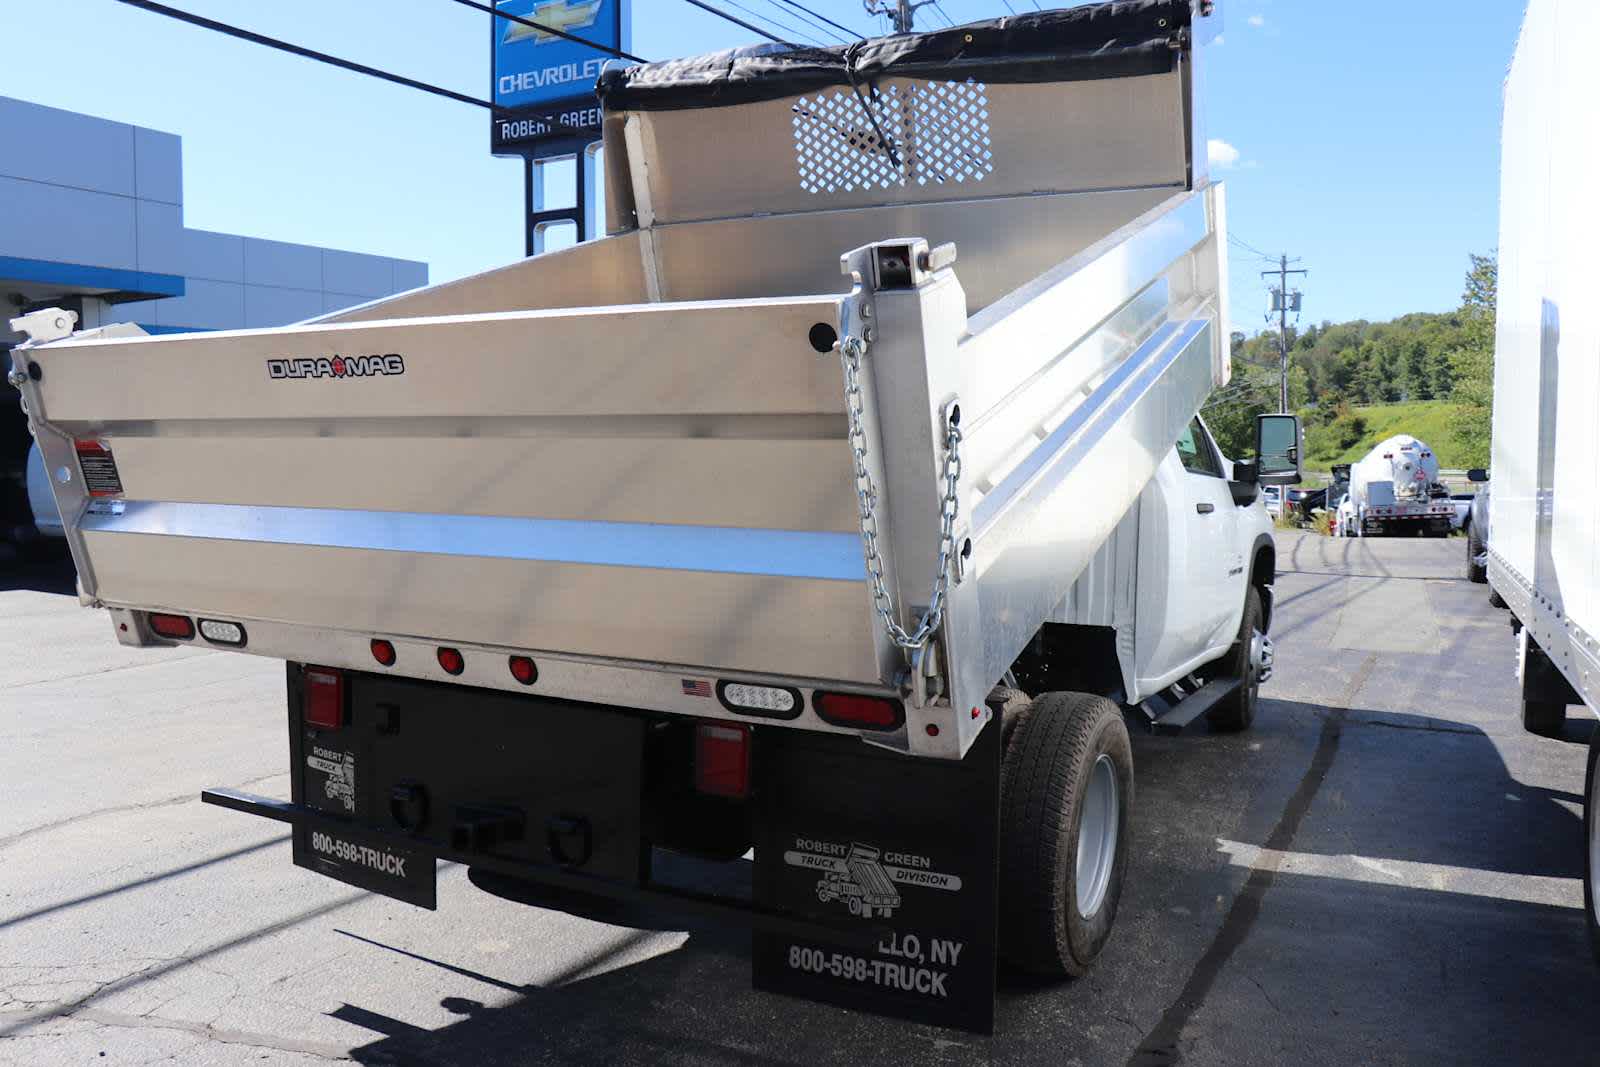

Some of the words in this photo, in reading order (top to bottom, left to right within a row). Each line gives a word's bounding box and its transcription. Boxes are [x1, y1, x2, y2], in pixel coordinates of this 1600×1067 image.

[500, 58, 607, 94] CHEVROLET
[313, 746, 342, 762] ROBERT
[316, 760, 337, 771] TRUCK
[312, 832, 406, 878] 800-598-TRUCK
[796, 838, 847, 855] ROBERT
[884, 852, 931, 868] GREEN
[800, 855, 836, 869] TRUCK
[896, 870, 949, 887] DIVISION
[930, 939, 962, 966] NY
[789, 945, 949, 997] 800-598-TRUCK
